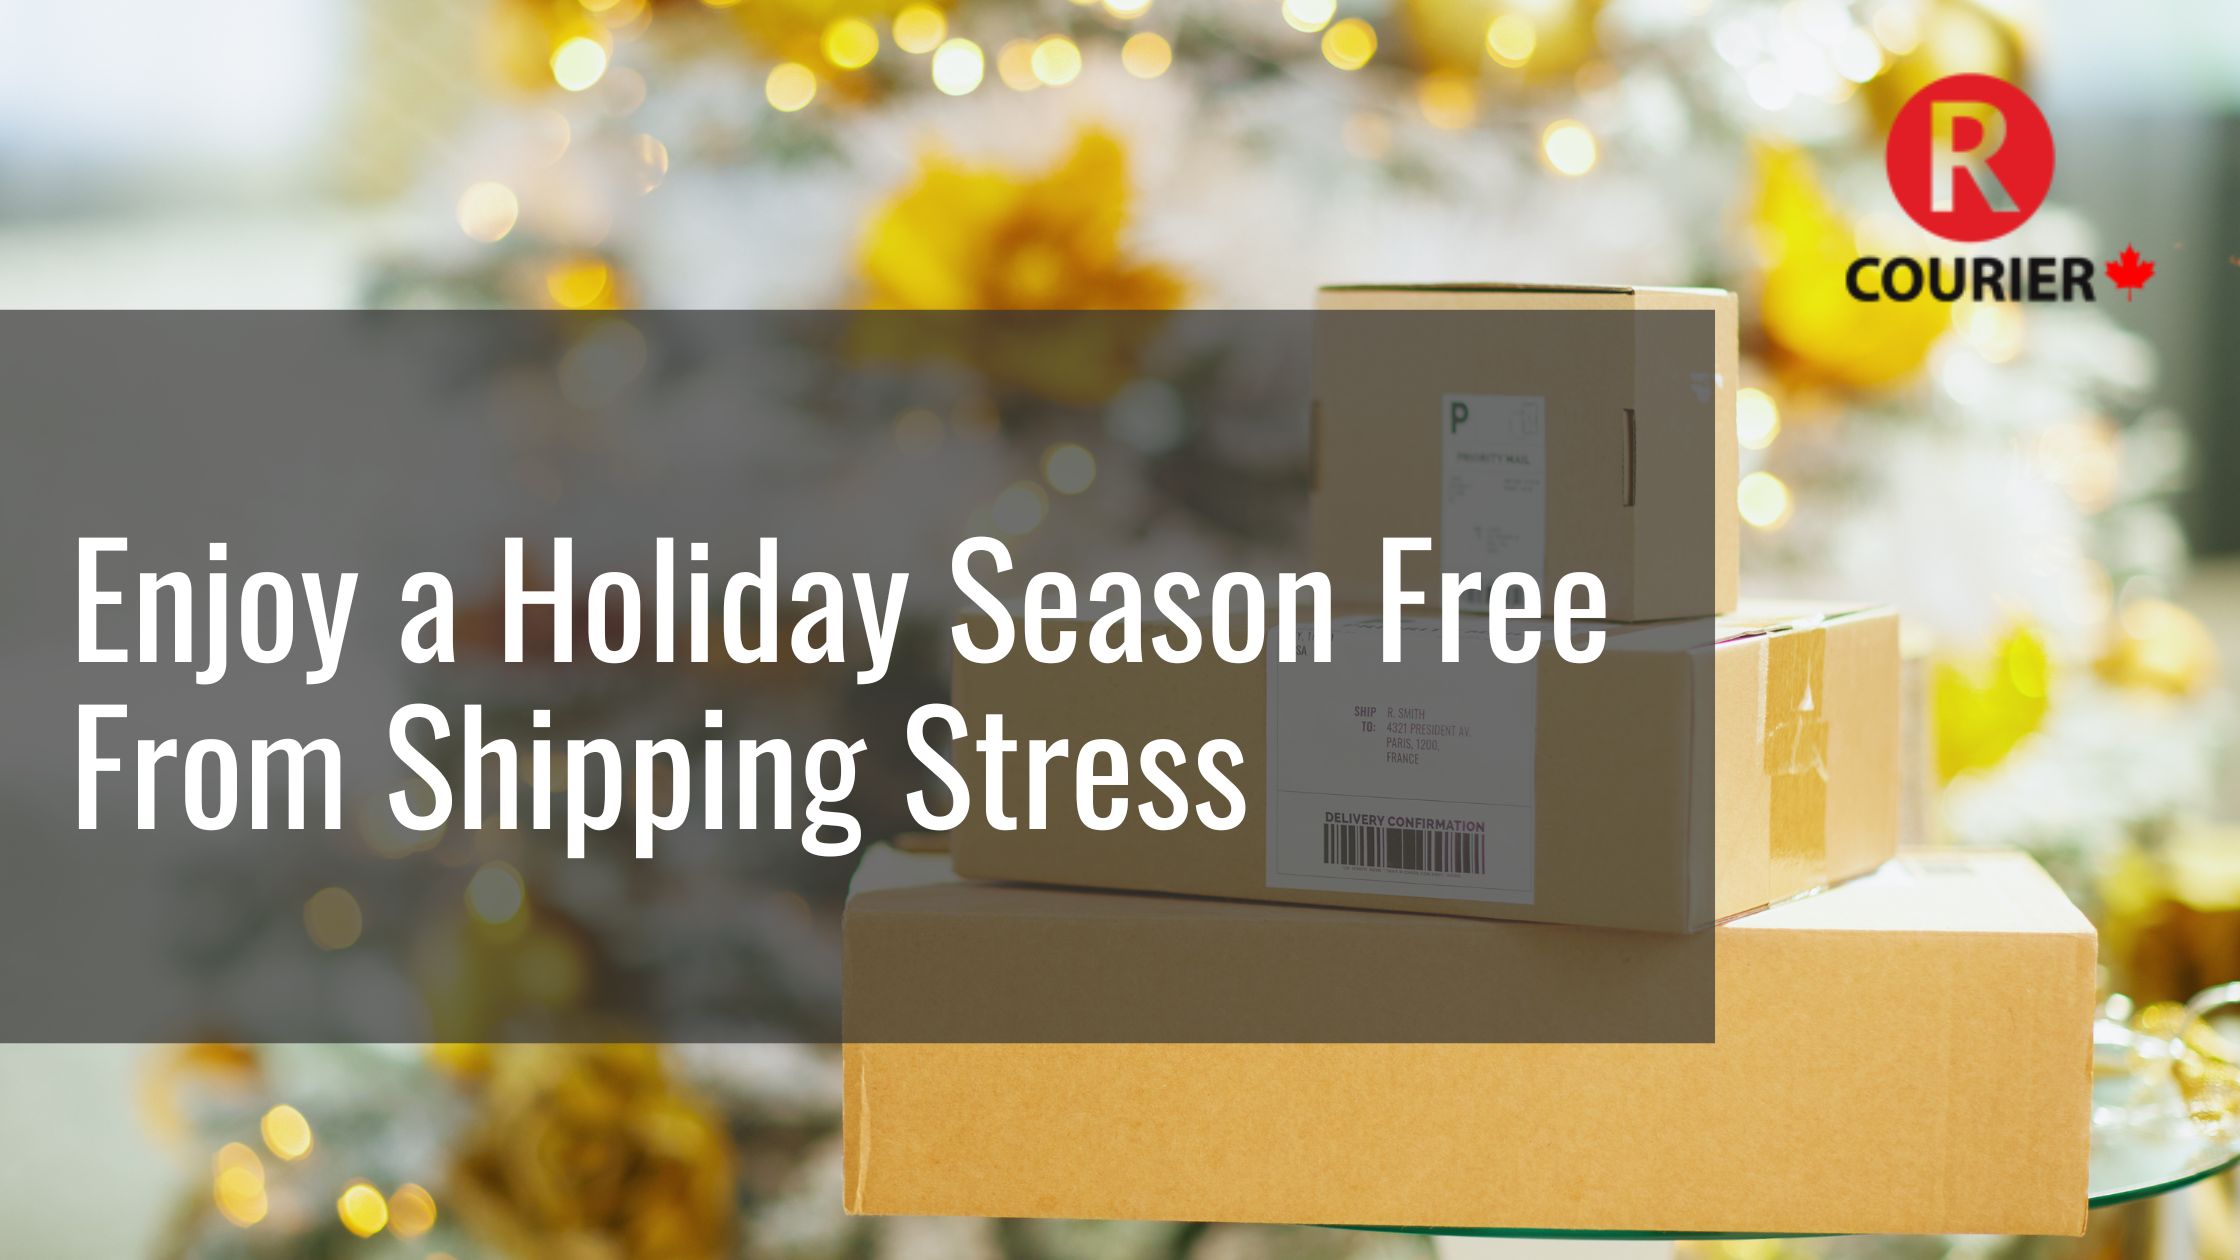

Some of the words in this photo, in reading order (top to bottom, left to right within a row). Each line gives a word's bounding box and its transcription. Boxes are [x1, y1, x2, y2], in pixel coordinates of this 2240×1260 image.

[1451, 401, 1469, 434] P
[1354, 706, 1377, 718] SHIP
[1387, 707, 1397, 719] R.
[1398, 707, 1425, 720] SMITH
[1361, 721, 1376, 733] TO:
[1386, 721, 1408, 734] 4321
[1410, 723, 1457, 737] PRESIDENT
[1386, 736, 1414, 751] PARIS,
[1386, 751, 1420, 765] FRANCE
[1325, 811, 1385, 827] DELIVERY
[1387, 816, 1486, 833] CONFIRMATION
